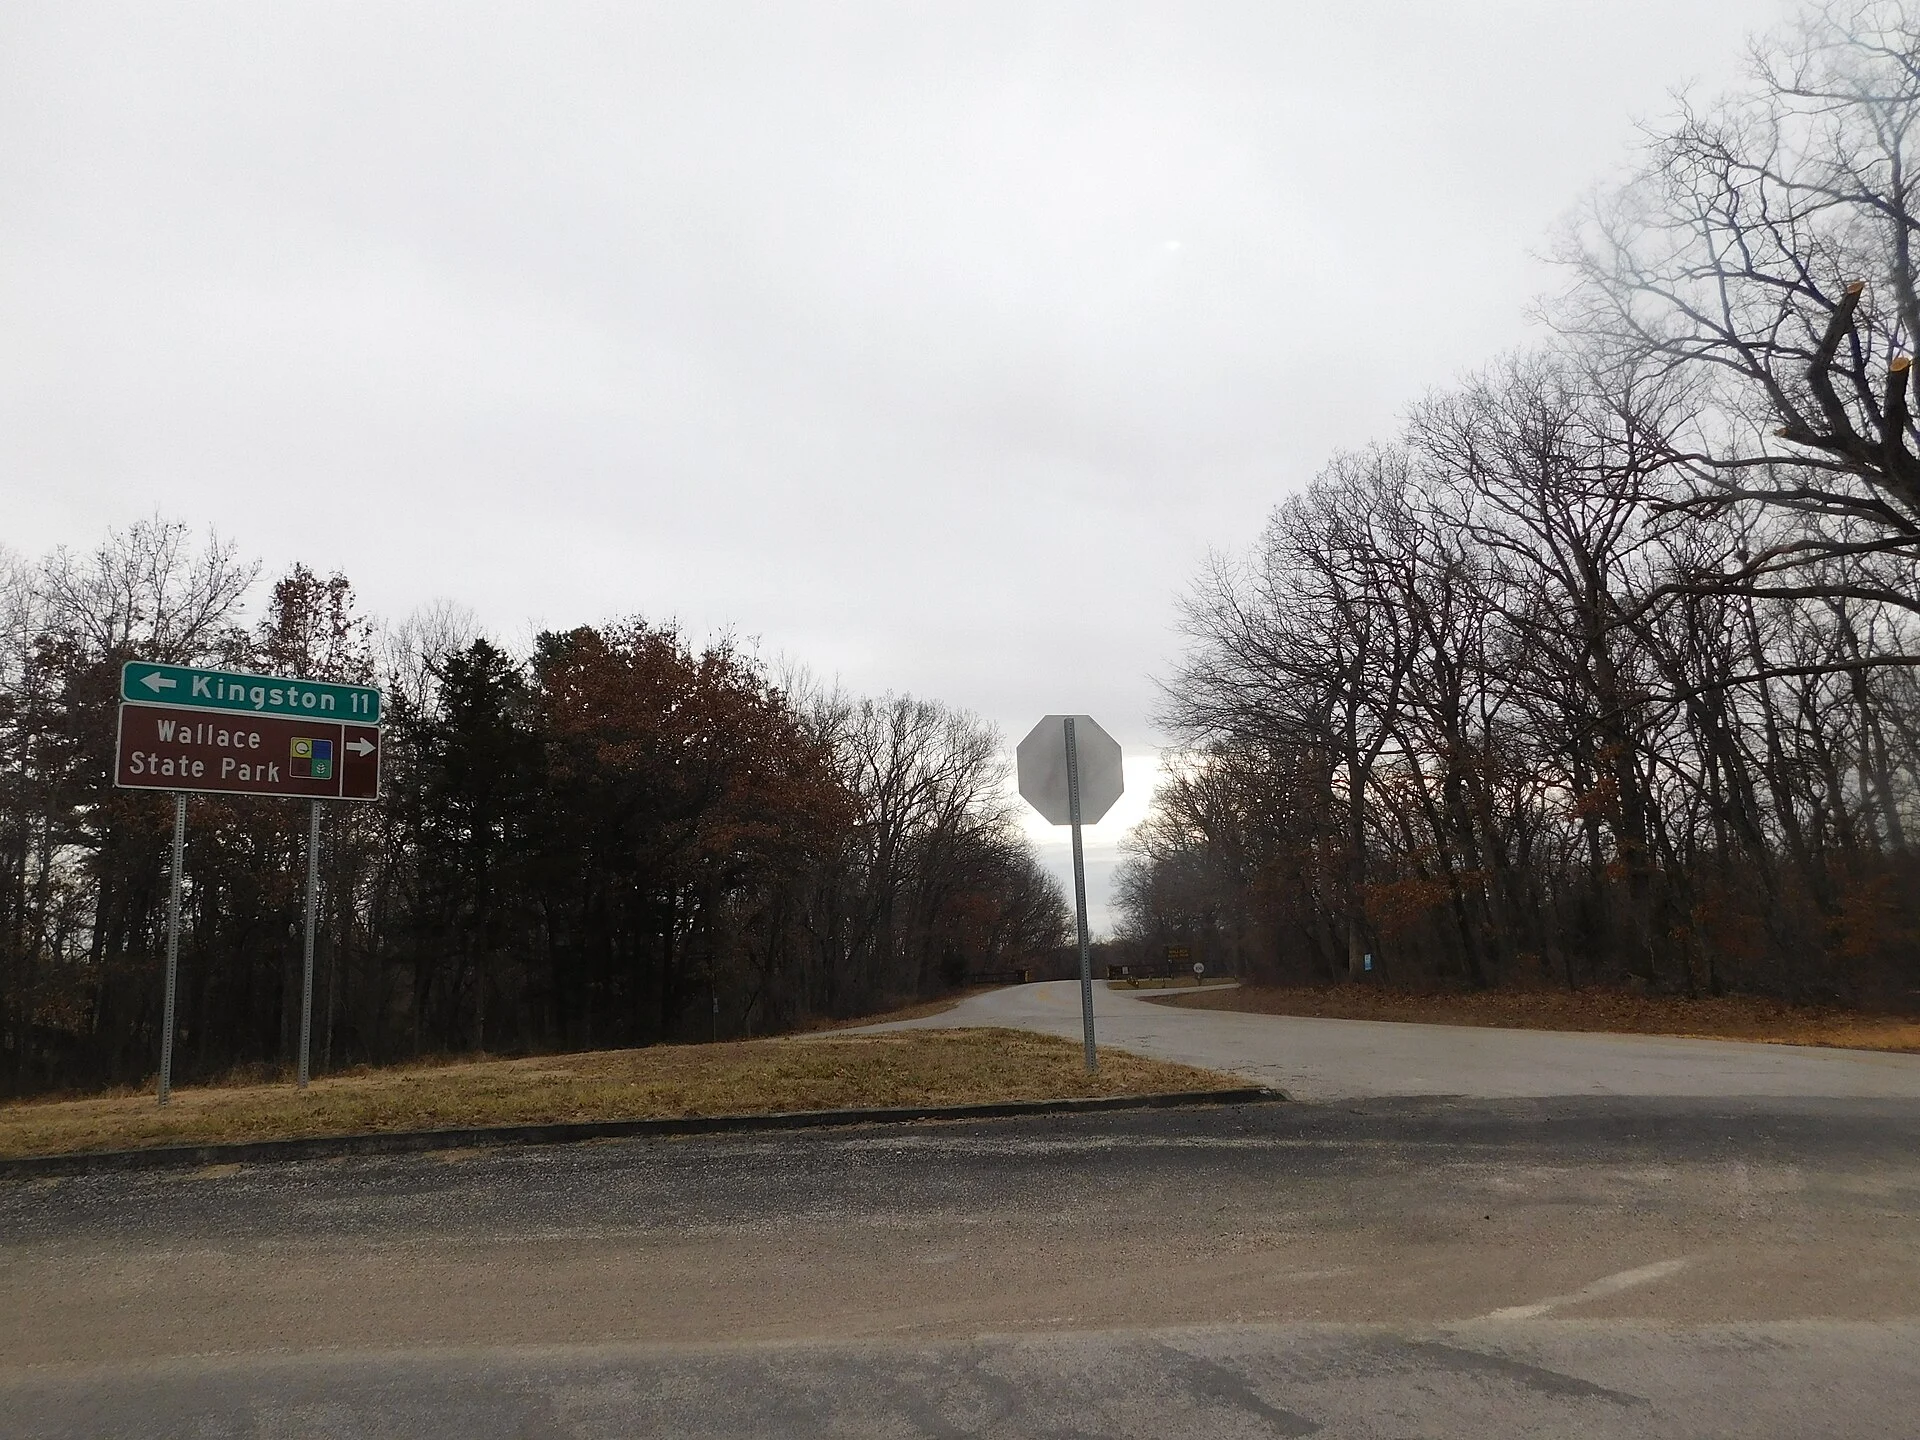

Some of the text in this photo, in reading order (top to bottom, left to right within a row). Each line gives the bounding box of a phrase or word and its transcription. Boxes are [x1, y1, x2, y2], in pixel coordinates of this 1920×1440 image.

[192, 675, 369, 714] Kingston 11
[157, 719, 262, 749] Wallace
[129, 750, 280, 783] State Park
